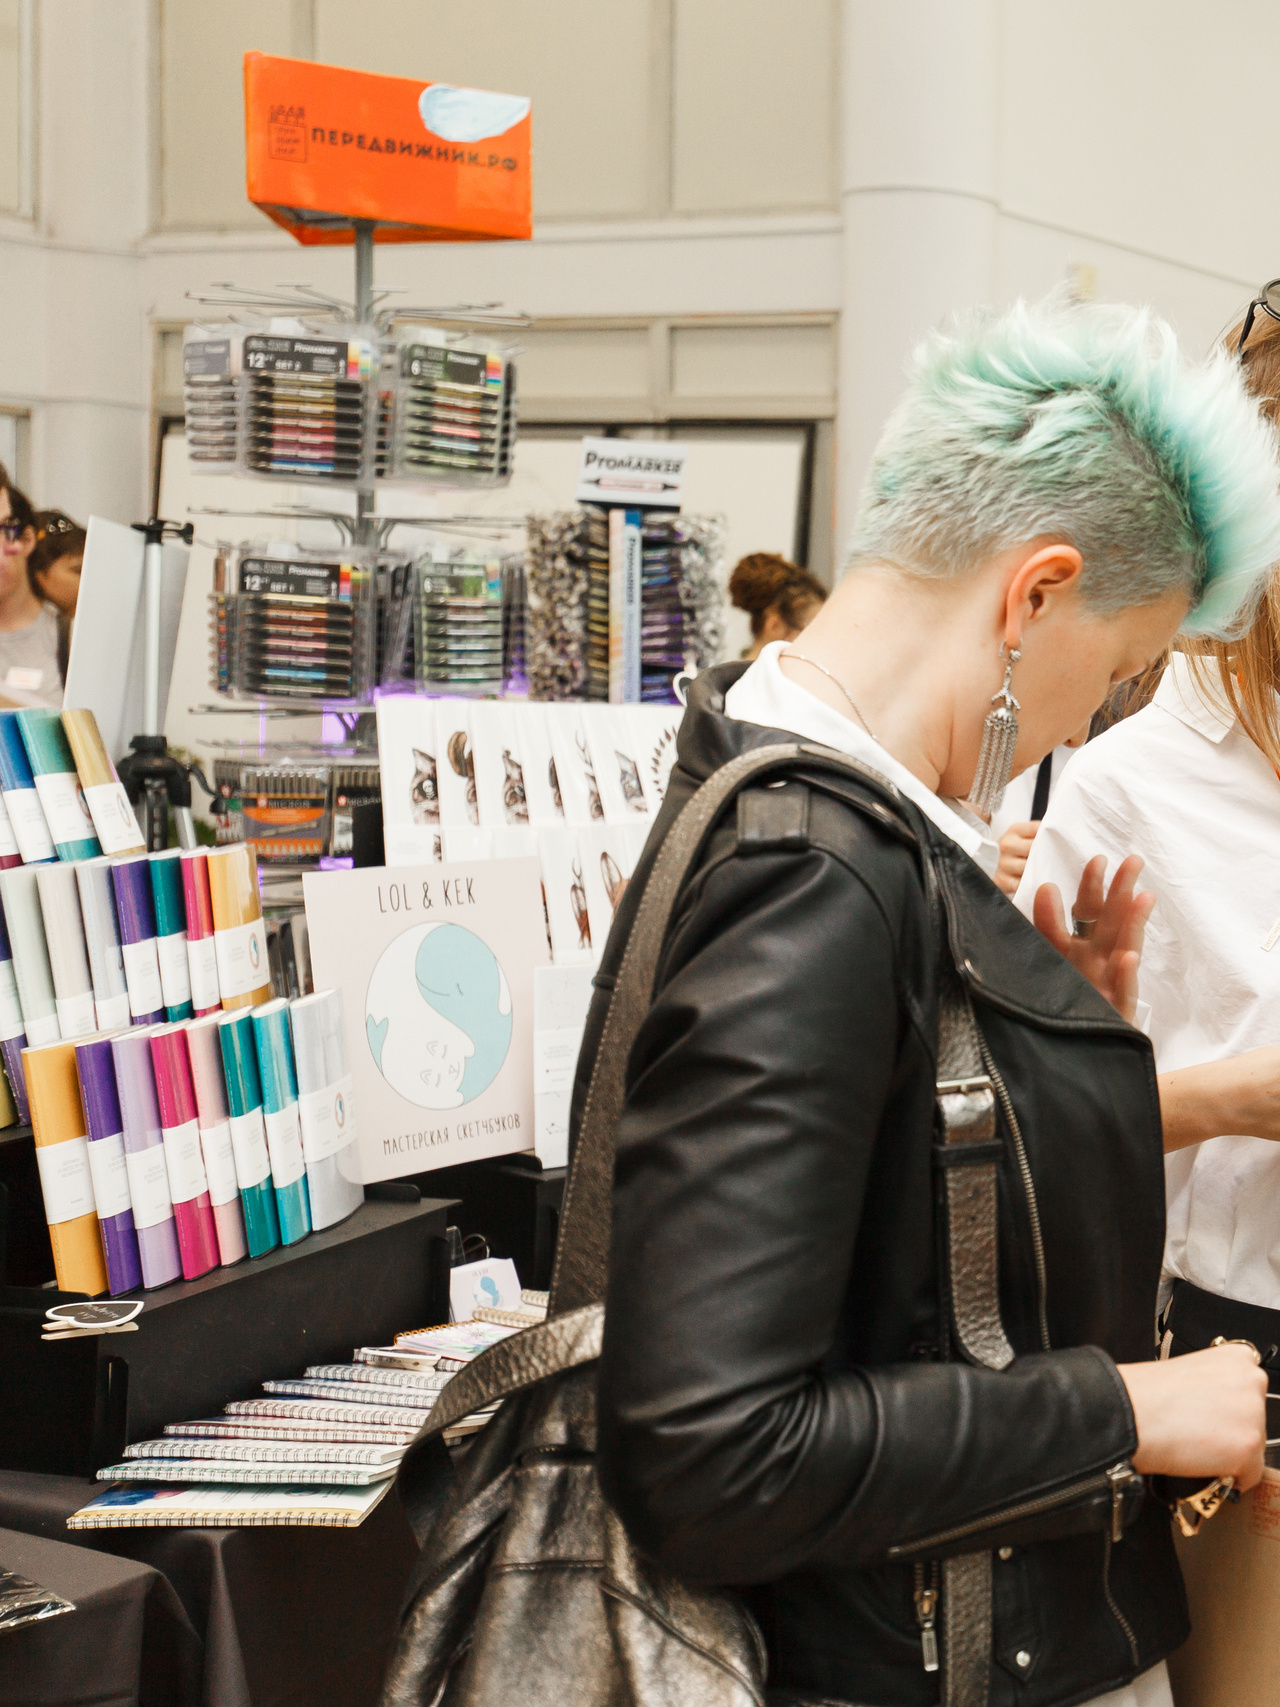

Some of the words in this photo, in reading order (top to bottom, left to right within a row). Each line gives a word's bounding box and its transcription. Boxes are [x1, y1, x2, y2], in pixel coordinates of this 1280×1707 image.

[310, 126, 518, 172] ПЕРЕДВИЖНИК.РФ
[246, 351, 267, 369] 12
[244, 573, 262, 591] 12
[378, 884, 412, 913] LOL
[422, 881, 433, 909] &
[442, 877, 476, 907] KEK
[382, 1126, 449, 1156] МАСТЕРСКАЯ
[456, 1113, 521, 1141] СКЕТЧБУКОВ
